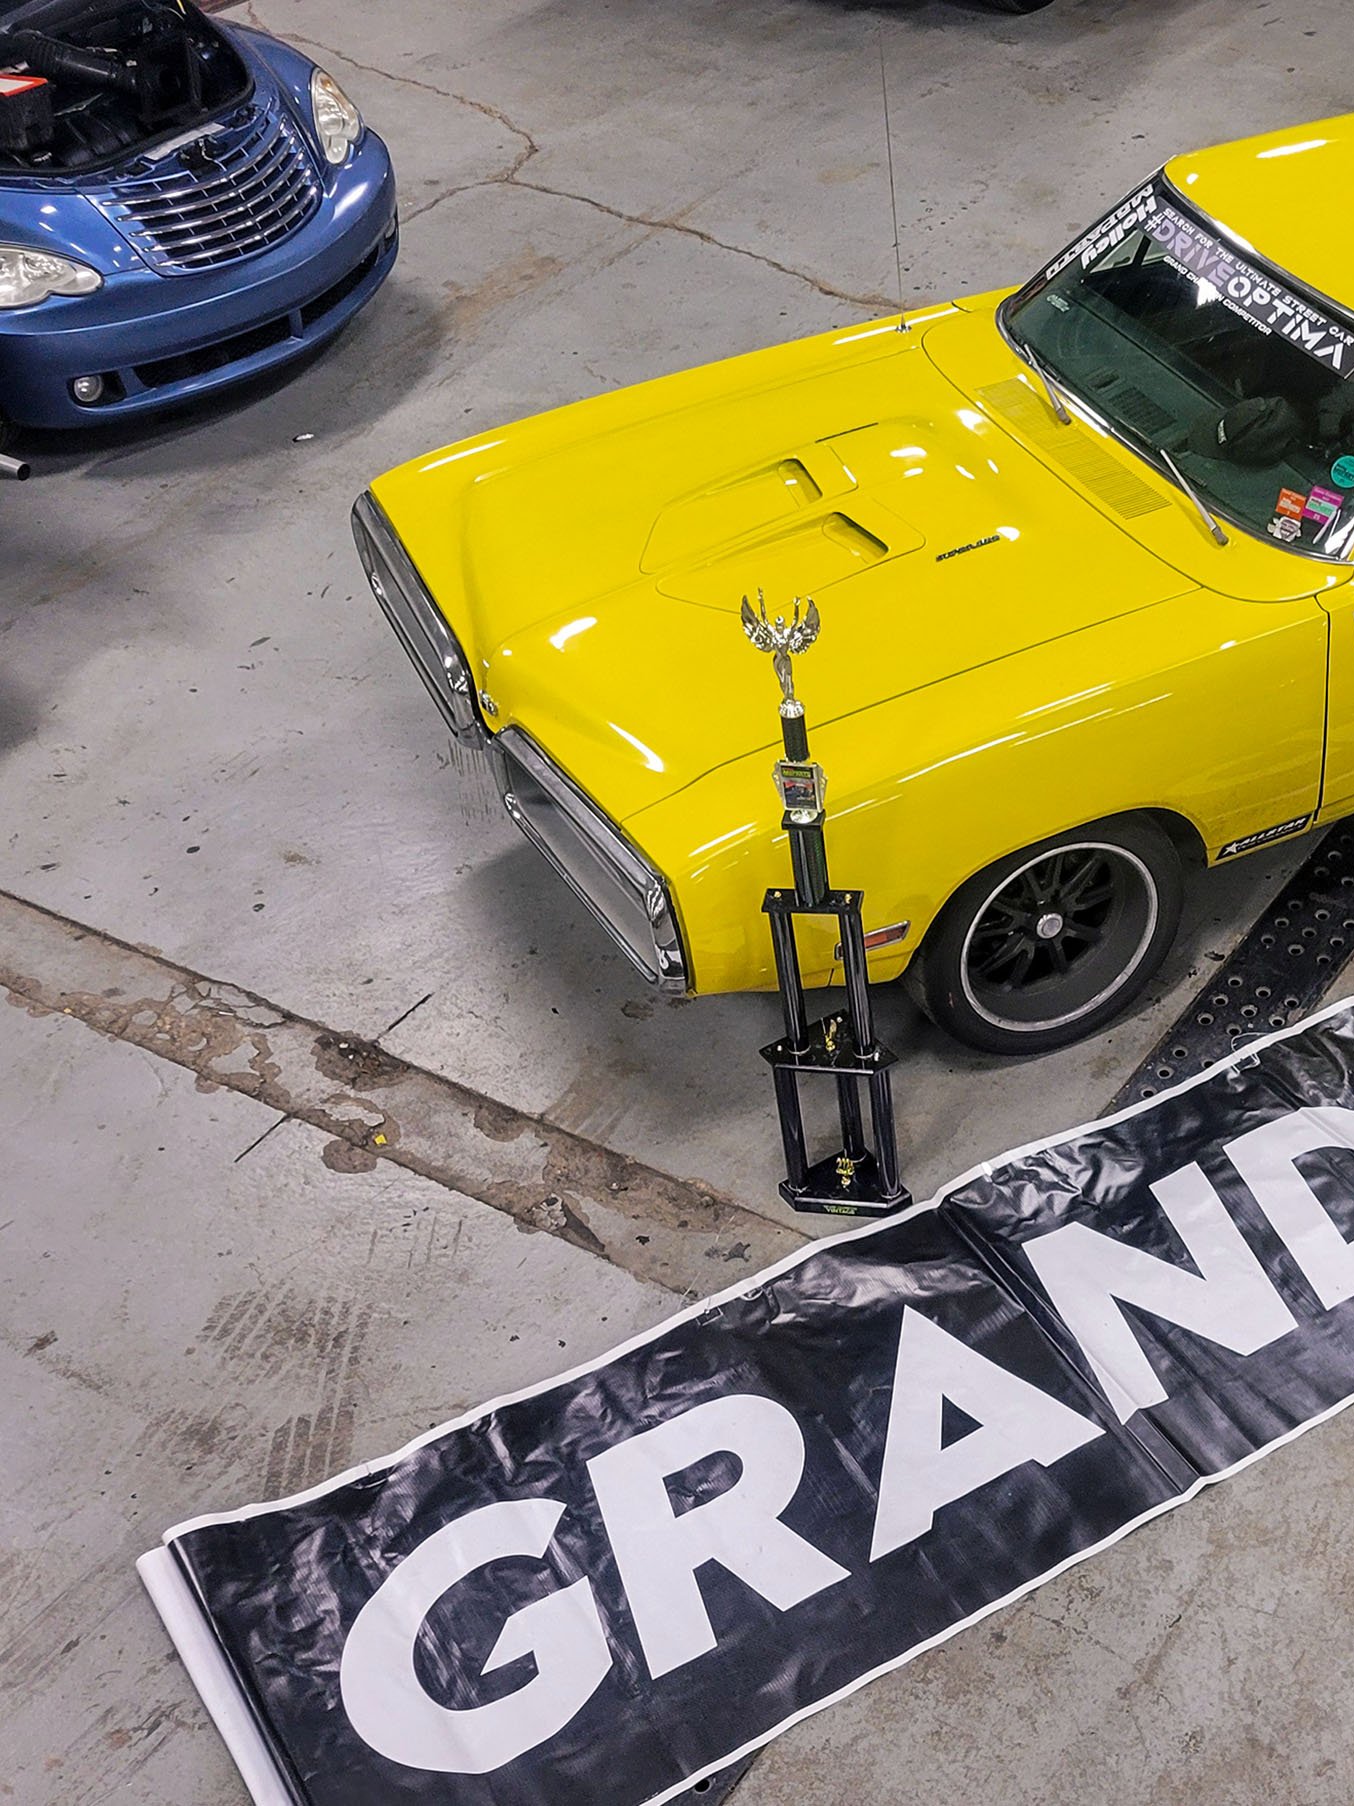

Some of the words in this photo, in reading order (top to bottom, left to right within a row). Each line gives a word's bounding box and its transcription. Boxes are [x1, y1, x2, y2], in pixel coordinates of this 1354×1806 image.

[1081, 195, 1157, 270] Holley
[1163, 207, 1195, 235] SEARCH
[1195, 232, 1214, 249] FOR
[1215, 246, 1234, 264] THE
[1235, 261, 1281, 296] ULTIMATE
[1282, 295, 1326, 327] STREET
[1328, 326, 1354, 346] CAR
[1163, 255, 1188, 275] GRAND
[1222, 298, 1273, 336] COMPETITOR
